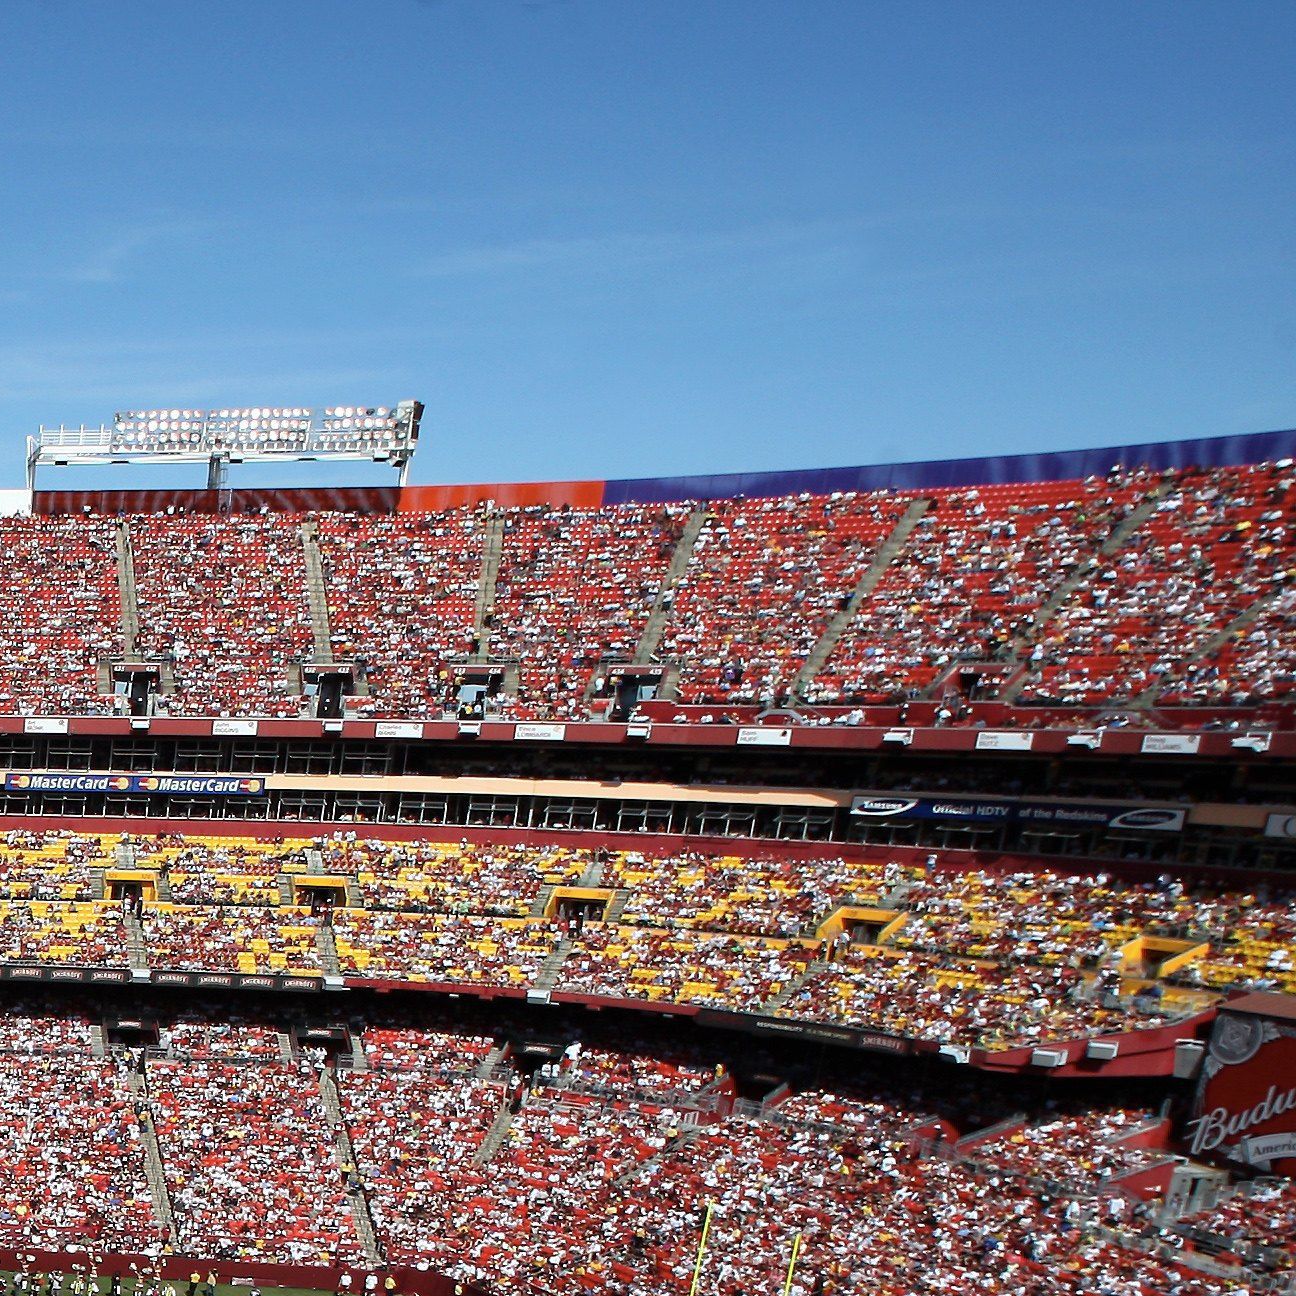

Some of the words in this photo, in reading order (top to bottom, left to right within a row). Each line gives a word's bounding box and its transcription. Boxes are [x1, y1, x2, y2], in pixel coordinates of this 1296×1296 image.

[29, 776, 109, 790] MasterCard
[158, 778, 240, 792] MasterCard
[933, 804, 973, 816] Official
[976, 806, 1009, 817] HDTV
[1033, 810, 1052, 819] the
